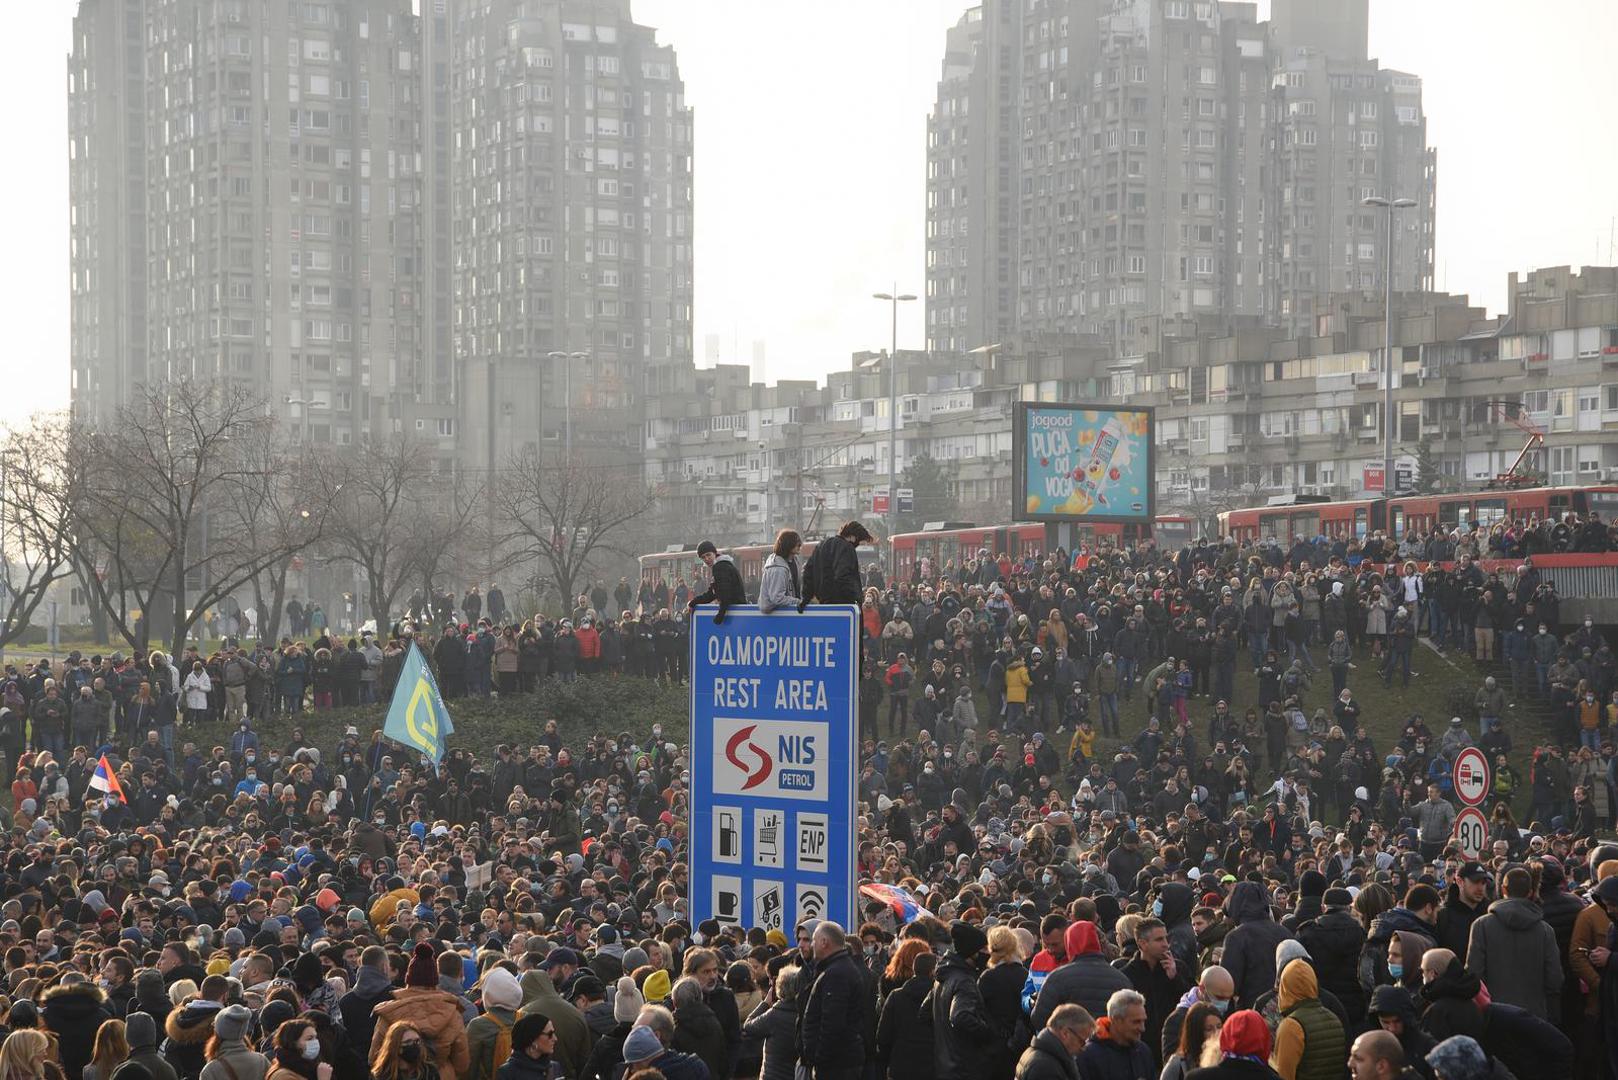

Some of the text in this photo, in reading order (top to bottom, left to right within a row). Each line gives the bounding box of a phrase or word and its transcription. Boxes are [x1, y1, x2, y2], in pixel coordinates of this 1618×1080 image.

[1032, 412, 1072, 428] jogood
[1056, 456, 1069, 473] od
[707, 635, 836, 668] ОДМОРИШТЕ
[714, 677, 828, 711] REST AREA
[778, 734, 815, 765] NIS
[782, 773, 812, 787] PETROL
[800, 829, 825, 855] ENP
[1461, 822, 1481, 851] 80
